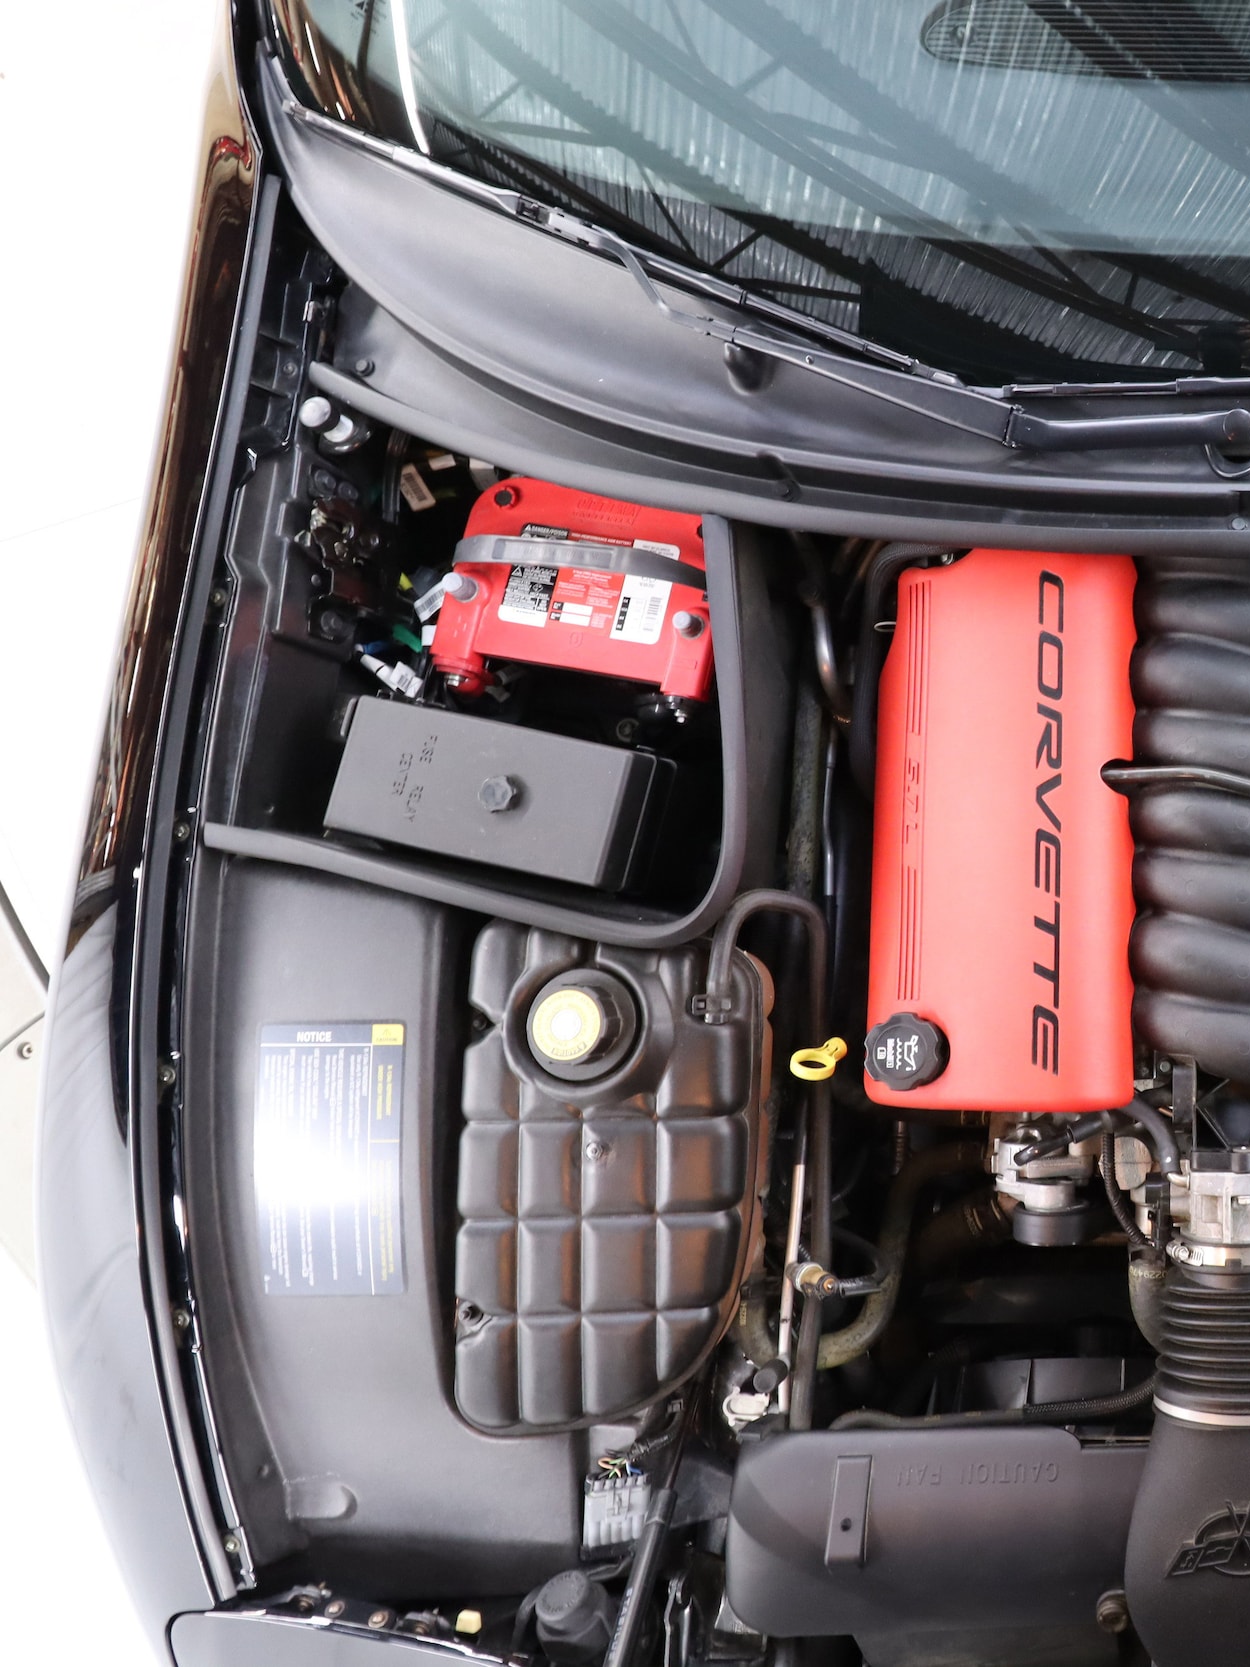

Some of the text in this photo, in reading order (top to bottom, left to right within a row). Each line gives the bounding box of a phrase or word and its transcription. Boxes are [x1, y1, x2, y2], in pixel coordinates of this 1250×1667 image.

[391, 753, 414, 796] CENTER
[406, 786, 424, 823] RELAY
[1030, 570, 1065, 1075] CORVETTE
[296, 1031, 332, 1043] NOTICE
[895, 1463, 1060, 1487] CAUTION FAN
